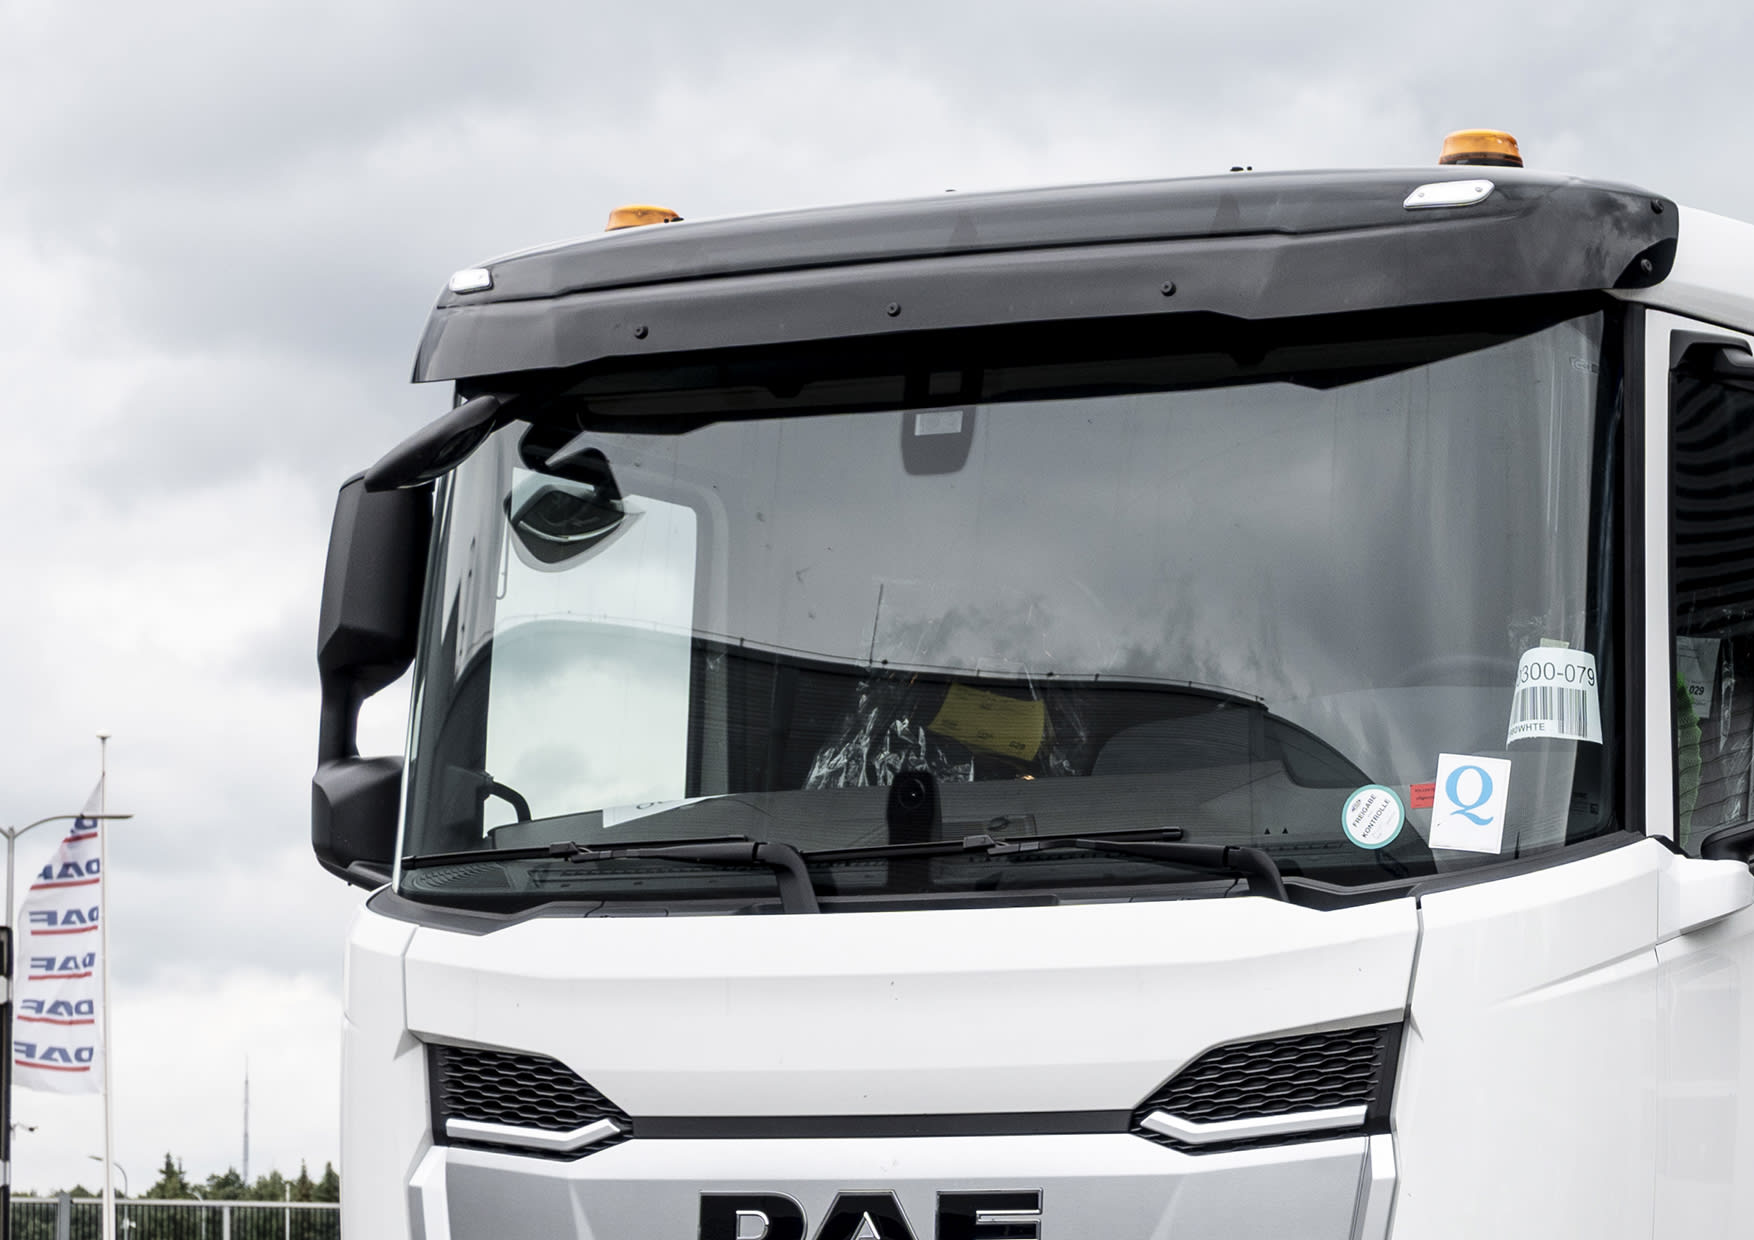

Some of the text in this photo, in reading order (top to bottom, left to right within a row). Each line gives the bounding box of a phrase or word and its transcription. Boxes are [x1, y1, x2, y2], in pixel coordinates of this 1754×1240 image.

[1352, 793, 1378, 828] FREIGABE
[1445, 765, 1494, 826] Q
[1362, 798, 1390, 838] KONTROLLE
